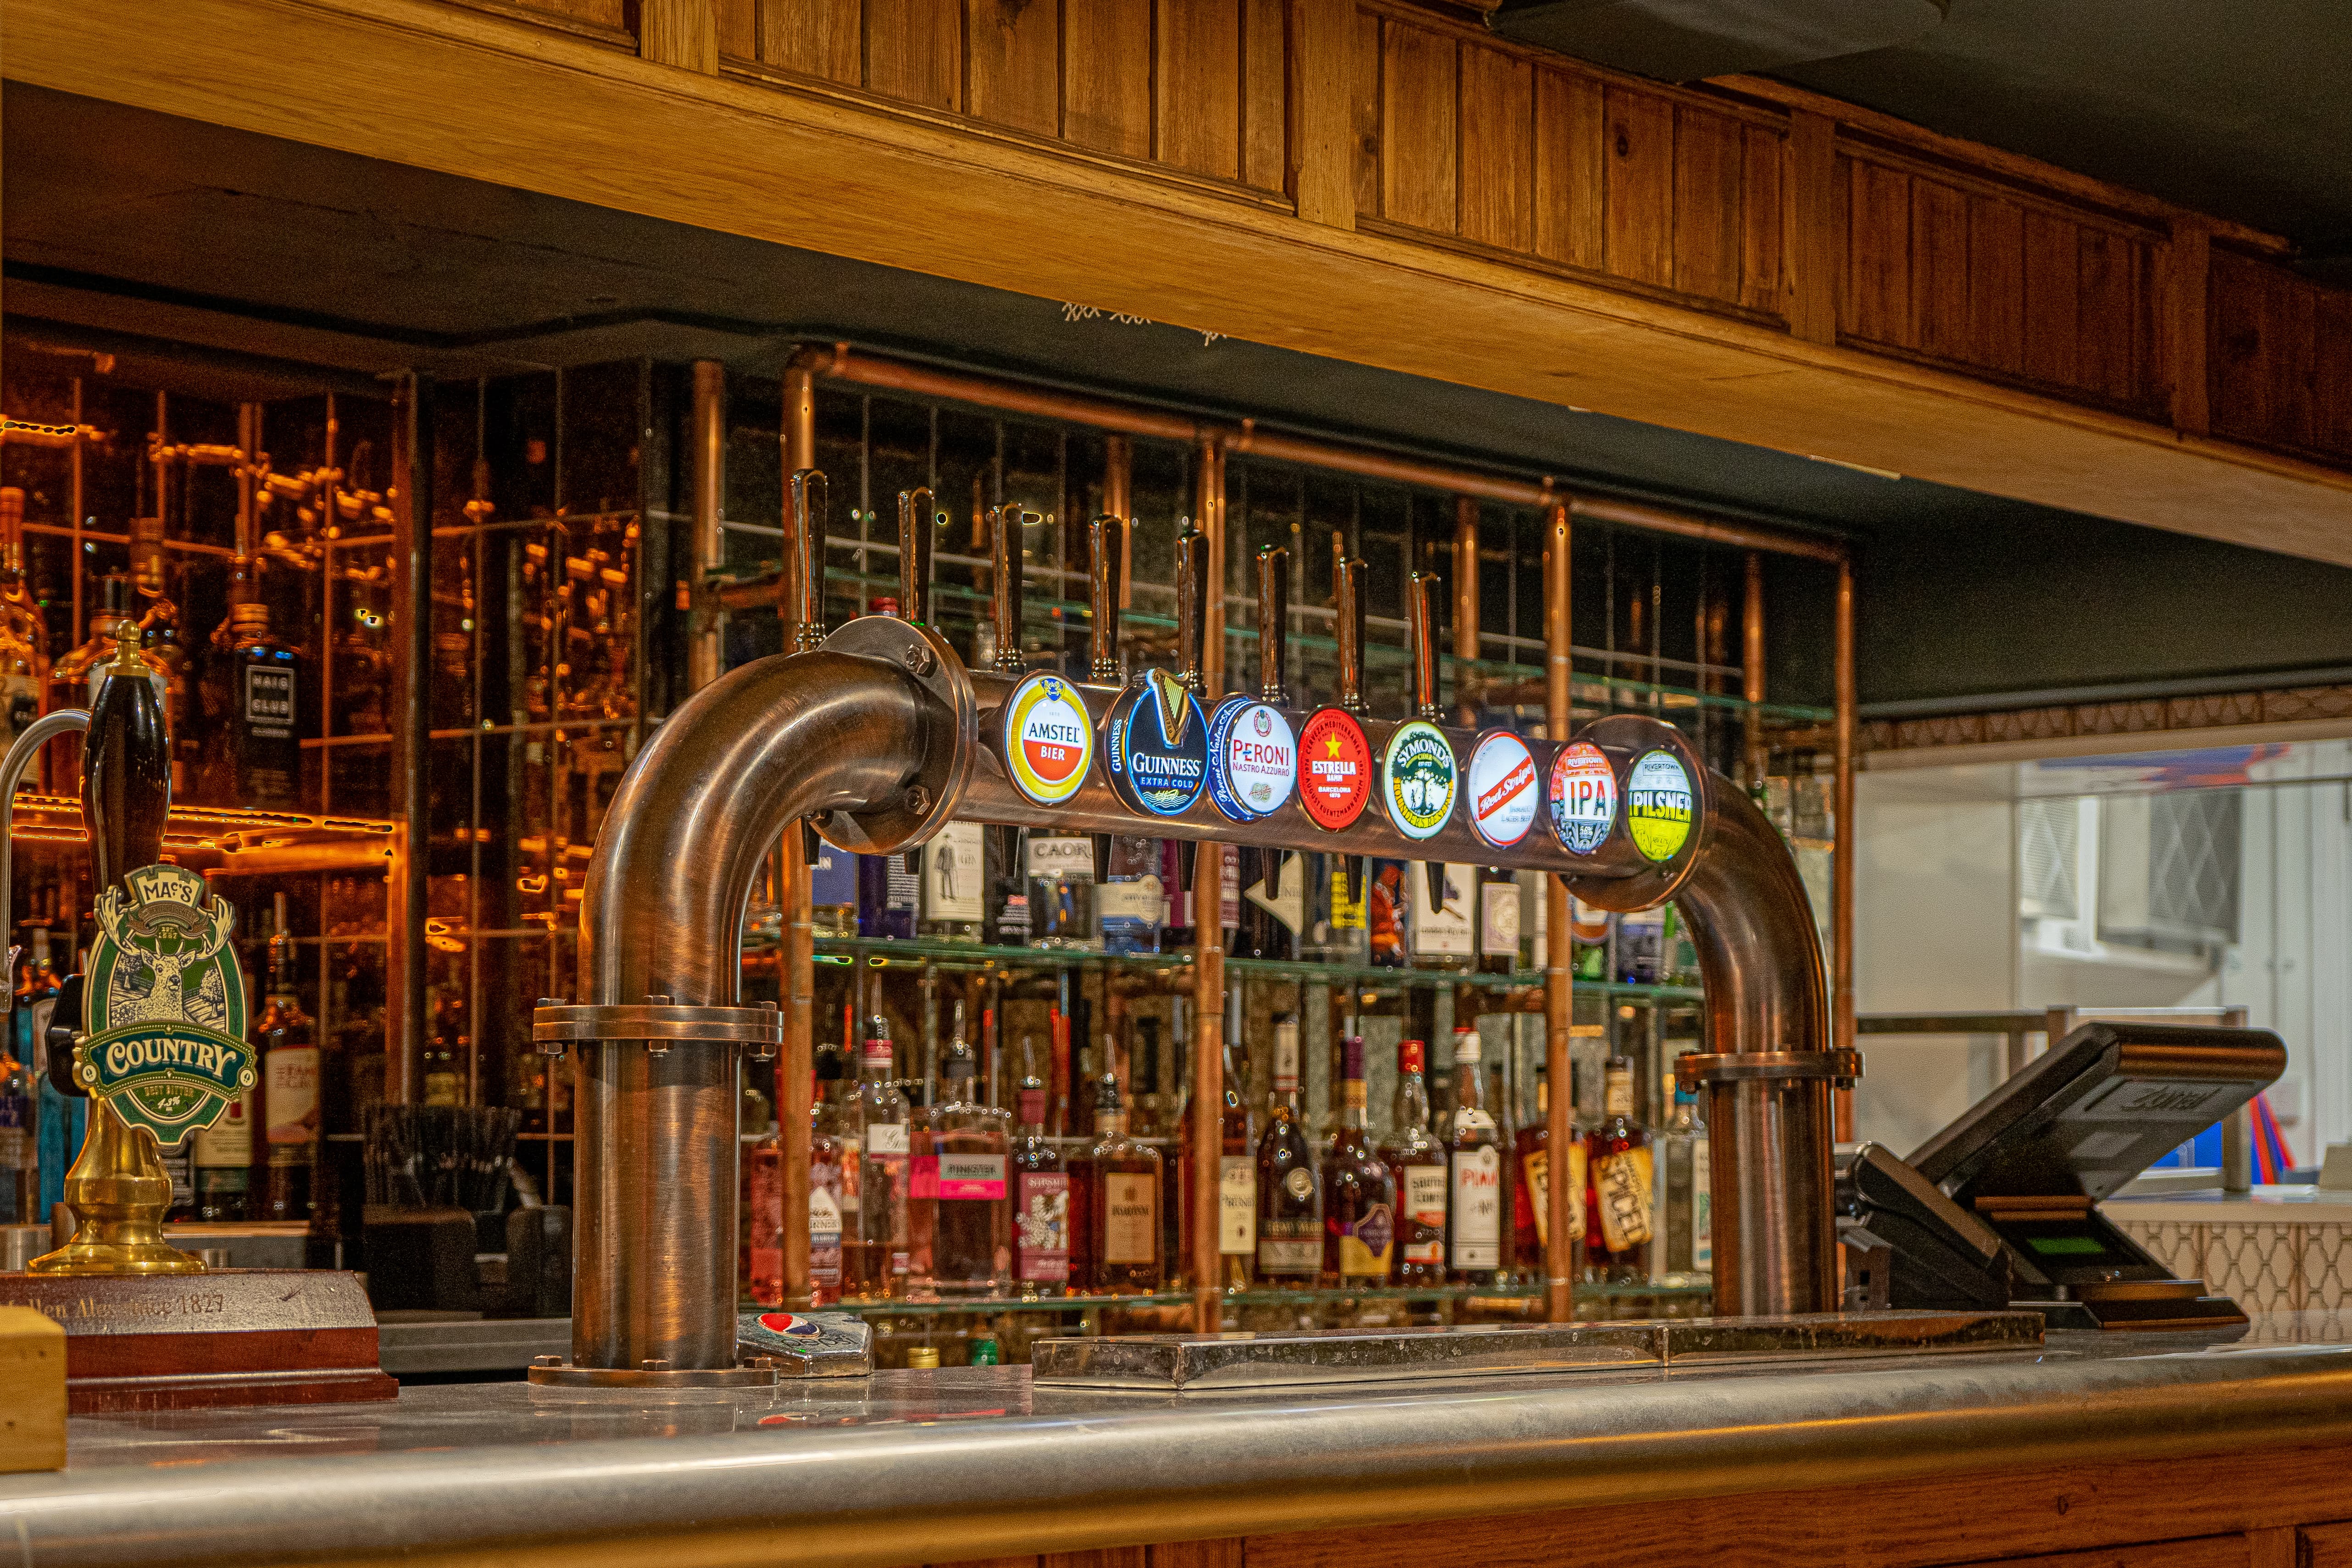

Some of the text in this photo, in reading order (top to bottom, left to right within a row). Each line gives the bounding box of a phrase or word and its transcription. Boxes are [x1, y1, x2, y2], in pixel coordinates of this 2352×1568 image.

[1029, 723, 1079, 743] AMSTEL
[1110, 718, 1123, 773] GUINNESS
[1306, 724, 1324, 755] CERVEZA
[1040, 745, 1066, 761] BIER
[1132, 751, 1201, 777] GUINNESS
[1233, 740, 1290, 766] PERONI
[1397, 739, 1451, 769] SYMONDS
[1567, 757, 1604, 767] RIVERTOWN
[1233, 762, 1290, 777] NASTRO AZZURRO
[1312, 761, 1357, 775] ESTRELLA
[1140, 777, 1194, 789] EXTRA COLD
[1480, 787, 1502, 815] Red
[1502, 763, 1532, 796] Stripe
[1306, 778, 1364, 817] AUGUST KUENTZMANN DAMM
[1570, 780, 1607, 817] IPA
[1633, 791, 1692, 823] PILSNER
[106, 1038, 237, 1080] COUNTRY
[77, 1296, 115, 1318] Ales
[180, 1294, 224, 1315] 1827
